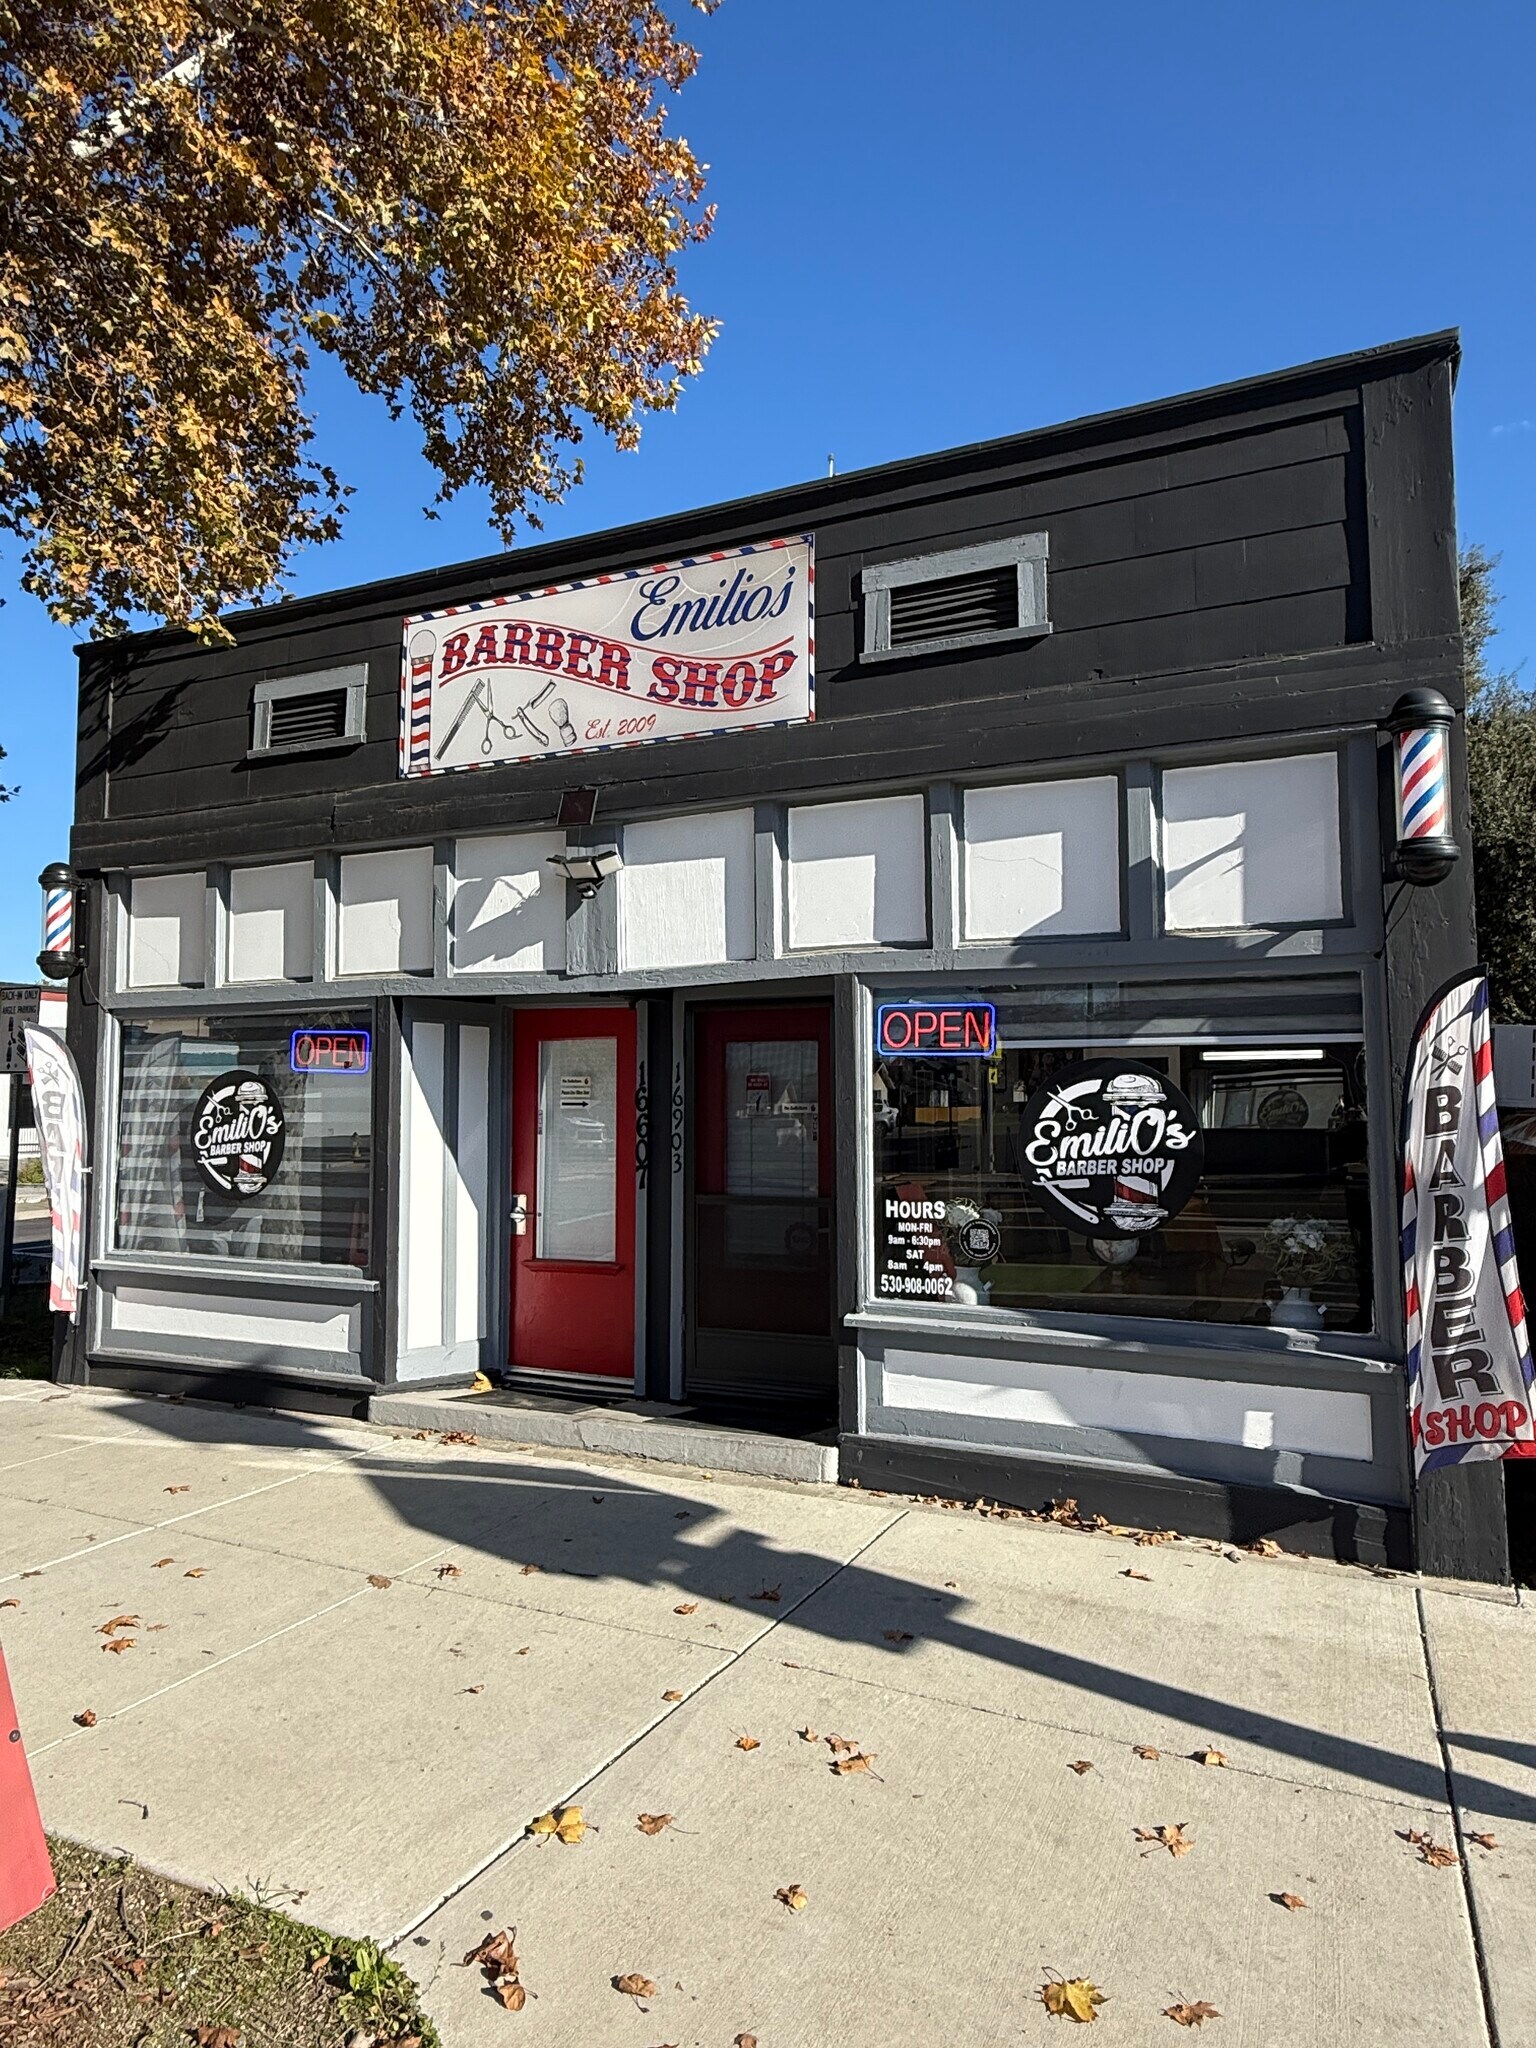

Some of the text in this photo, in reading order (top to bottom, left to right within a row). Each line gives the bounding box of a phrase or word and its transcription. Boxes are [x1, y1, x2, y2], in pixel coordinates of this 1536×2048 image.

[438, 623, 798, 707] BARBER SHOP
[585, 714, 656, 739] Est. 2009
[883, 1011, 990, 1048] OPEN
[296, 1036, 366, 1067] OPEN
[671, 1062, 683, 1174] 16903
[210, 1139, 266, 1156] BARBER SHOP
[1056, 1158, 1165, 1176] BARBER SHOP
[885, 1199, 945, 1219] HOURS
[898, 1222, 933, 1233] MON-FRI
[888, 1235, 905, 1245] 9am
[911, 1236, 941, 1247] 6:30pm
[1424, 1084, 1504, 1403] BARBER
[906, 1250, 924, 1259] SAT
[887, 1260, 907, 1270] 8am
[923, 1261, 943, 1272] 4pm
[881, 1274, 953, 1296] 530-908-0062
[1425, 1399, 1527, 1445] SHOP
